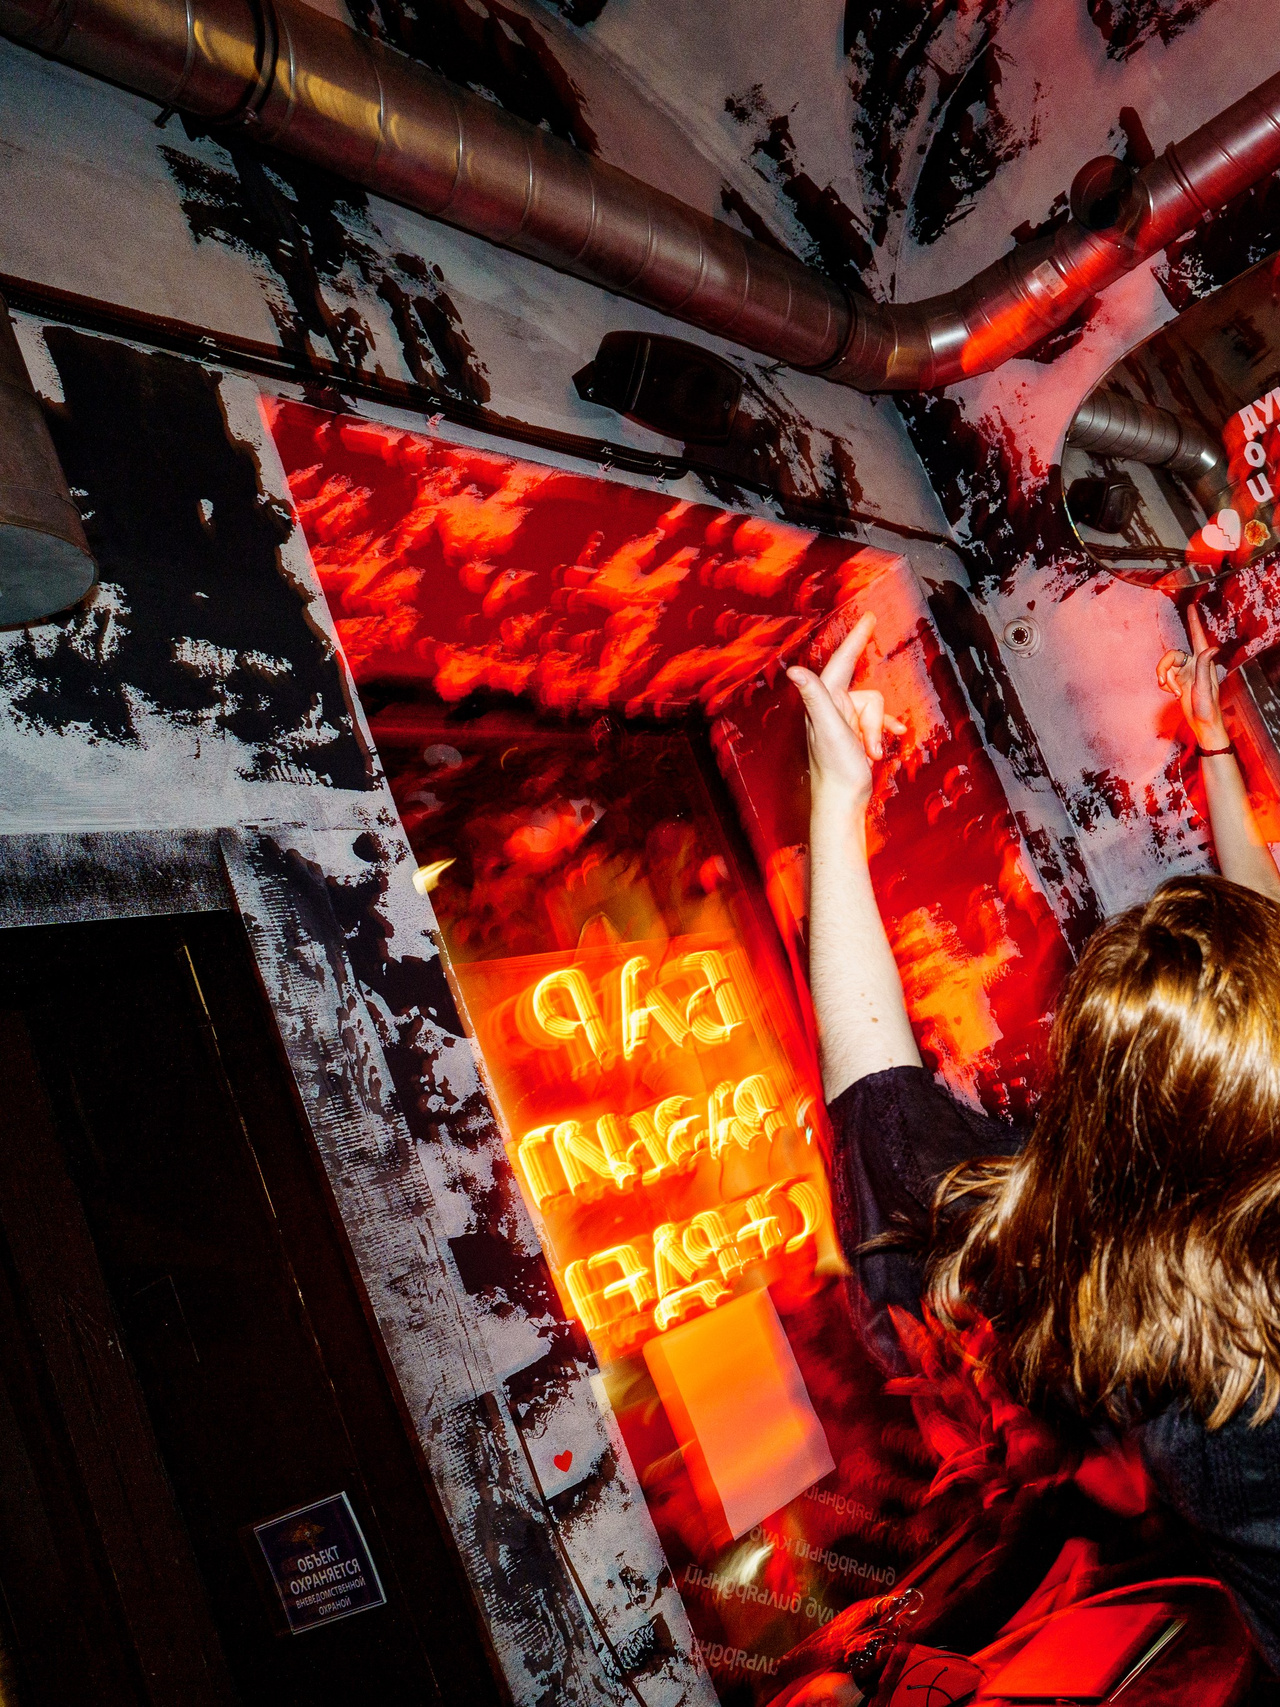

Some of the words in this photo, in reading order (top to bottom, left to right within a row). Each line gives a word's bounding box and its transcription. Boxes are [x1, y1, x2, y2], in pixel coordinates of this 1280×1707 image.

[1243, 441, 1267, 468] О
[297, 1545, 339, 1573] ОБЪЕКТ
[290, 1558, 361, 1595] ОХРАНЯЕТСЯ
[295, 1575, 366, 1609] ВНЕВЕДОМСТВЕННОЙ
[318, 1595, 352, 1615] ОХРАНОЙ
